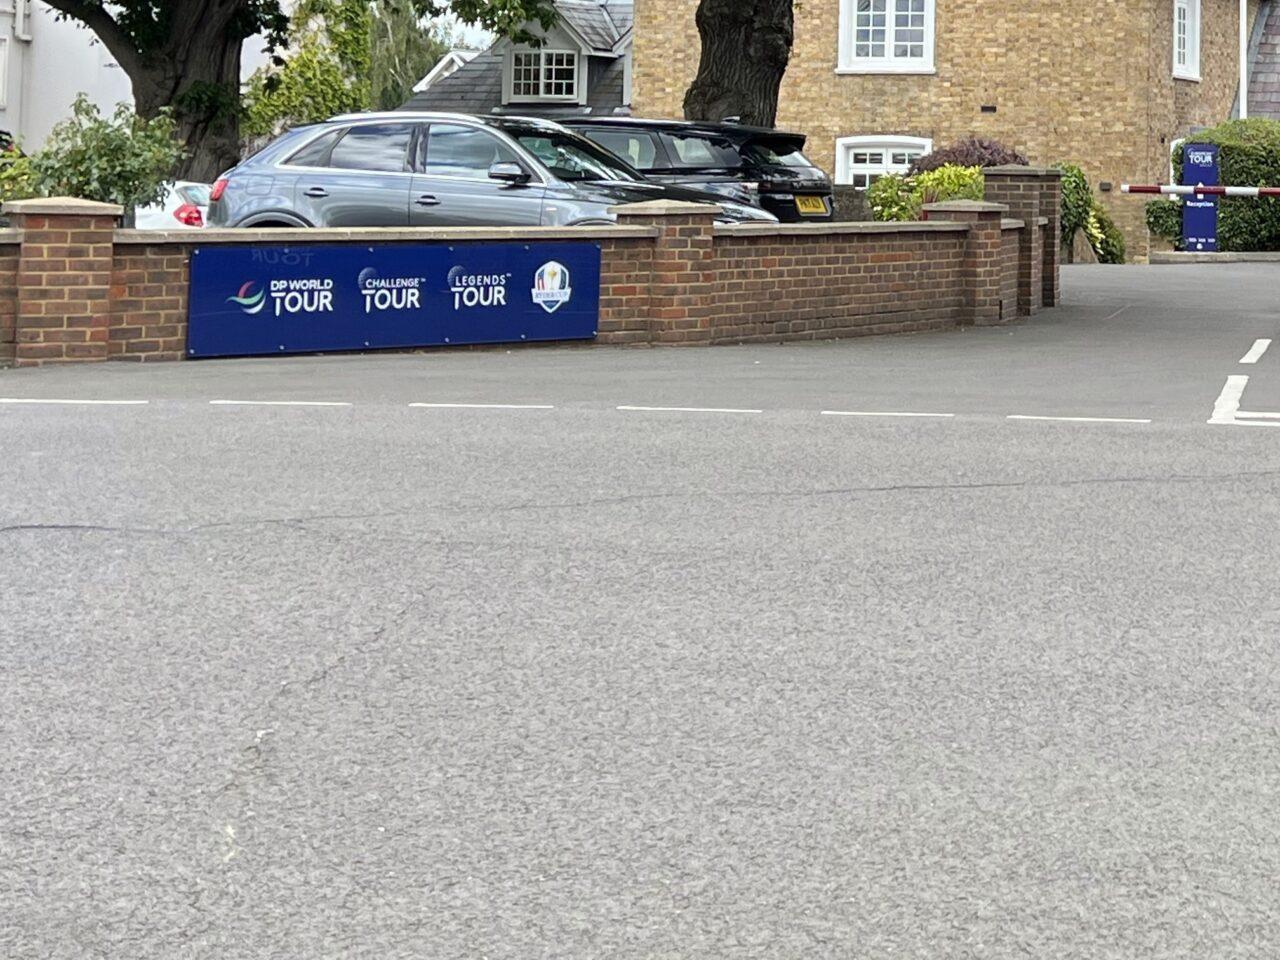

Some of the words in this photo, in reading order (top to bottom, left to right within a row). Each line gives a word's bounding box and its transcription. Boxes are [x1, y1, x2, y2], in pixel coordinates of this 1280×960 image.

[1189, 153, 1213, 164] TOUR
[270, 280, 288, 291] DP
[289, 279, 333, 290] WORLD
[365, 277, 420, 289] CHALLENGE
[455, 274, 506, 287] LEGENDS
[270, 290, 334, 317] TOUR
[361, 288, 421, 314] TOUR
[451, 286, 507, 311] TOUR
